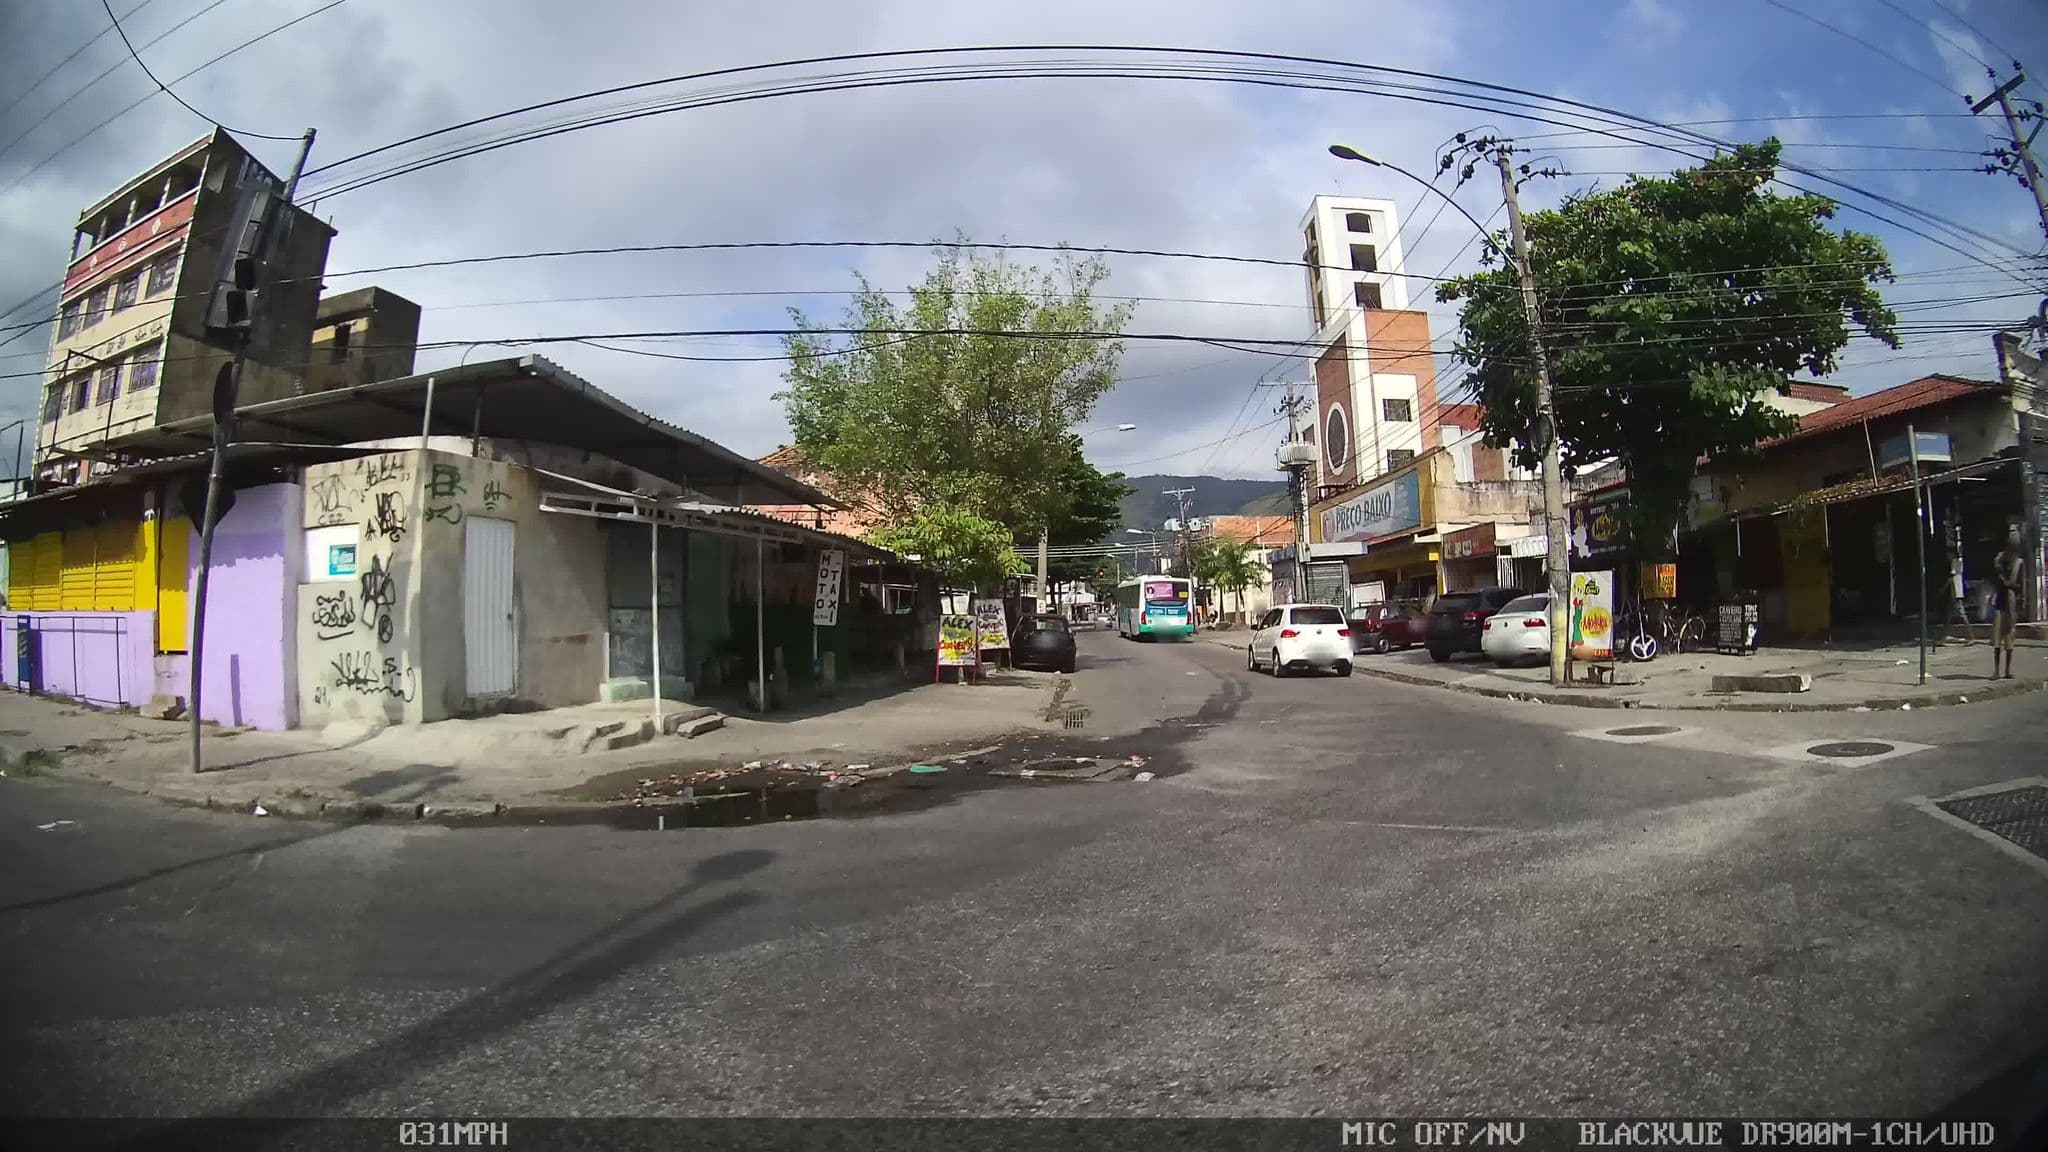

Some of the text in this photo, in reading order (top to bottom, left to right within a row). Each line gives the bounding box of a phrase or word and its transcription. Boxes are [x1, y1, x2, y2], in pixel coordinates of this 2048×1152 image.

[1335, 491, 1392, 533] PREÇO BAIXO
[816, 554, 831, 609] MOTO
[828, 570, 839, 622] TAXI
[942, 616, 974, 630] ALEX
[976, 604, 1001, 617] ALEX
